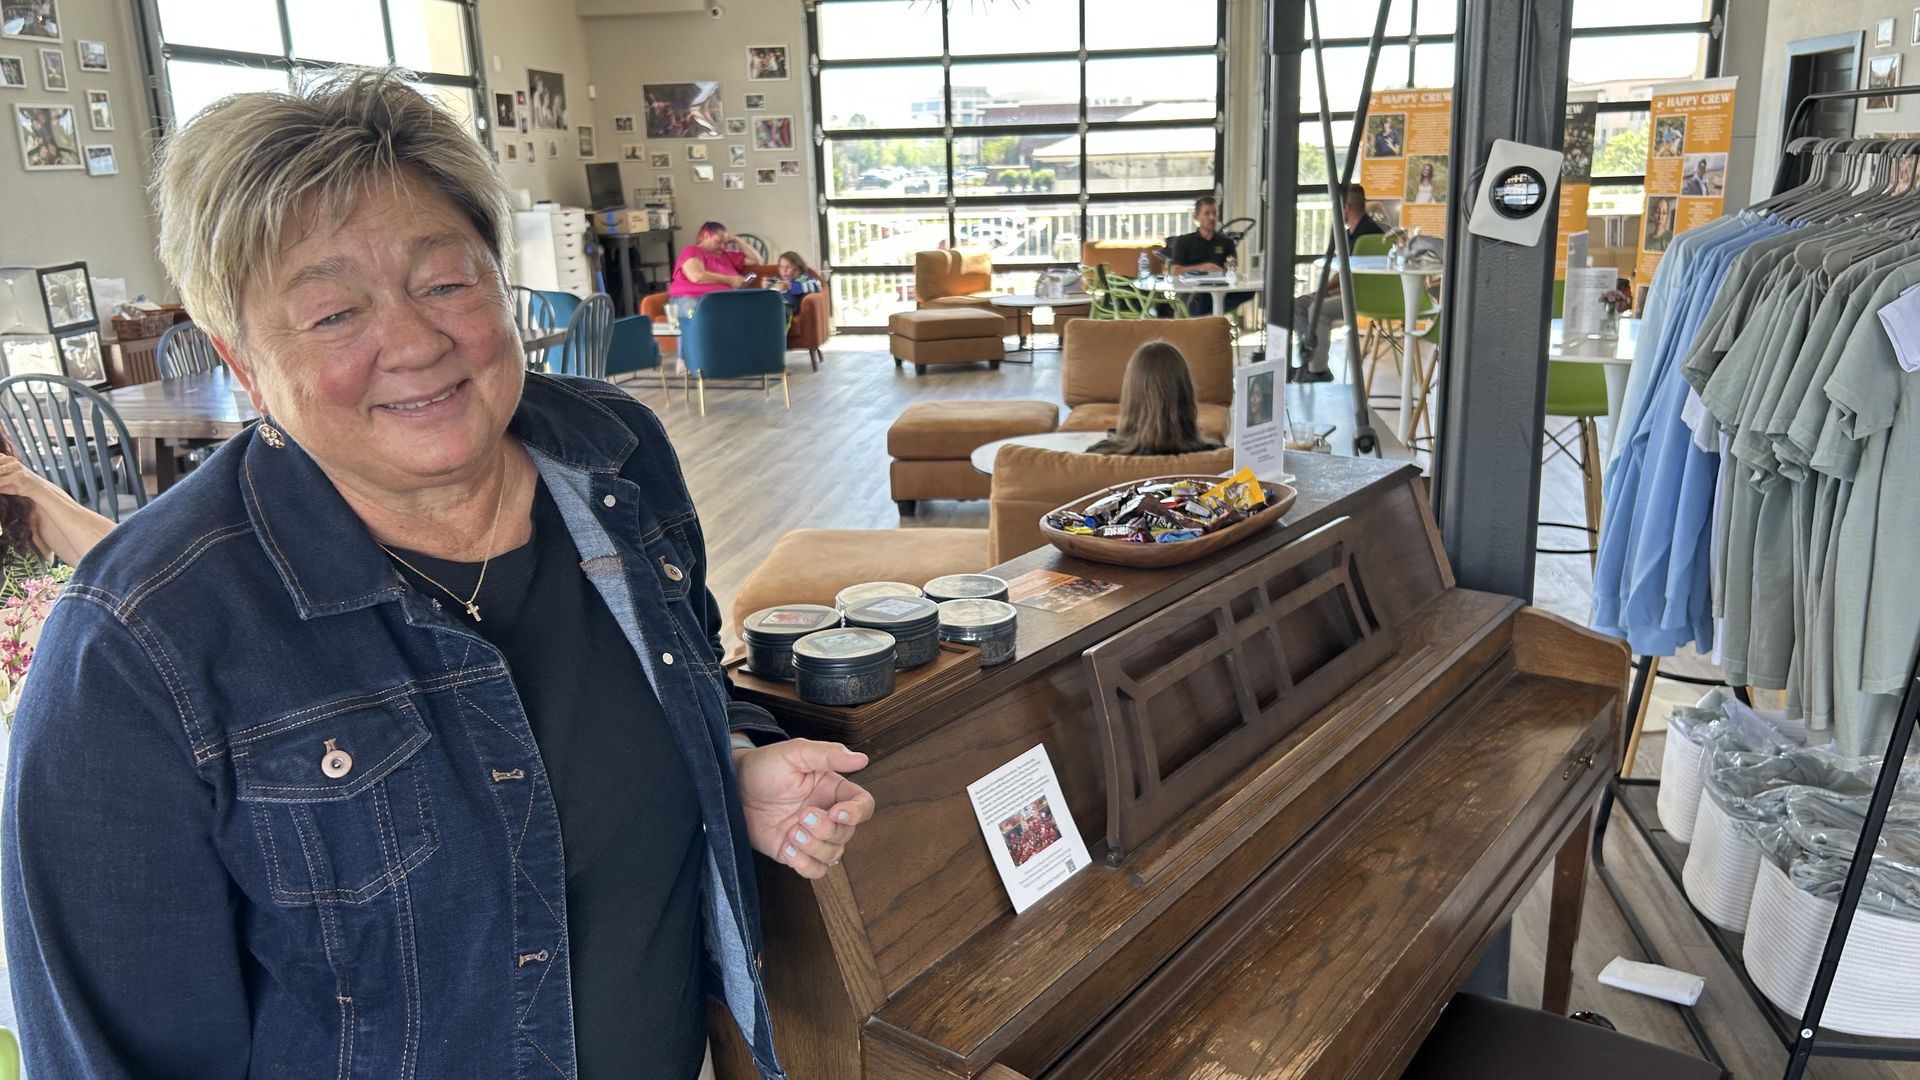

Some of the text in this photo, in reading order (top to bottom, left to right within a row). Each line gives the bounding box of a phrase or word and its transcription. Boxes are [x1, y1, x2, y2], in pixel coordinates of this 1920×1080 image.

[1382, 93, 1418, 104] HAPPY
[1666, 92, 1732, 107] HAPPY CREW
